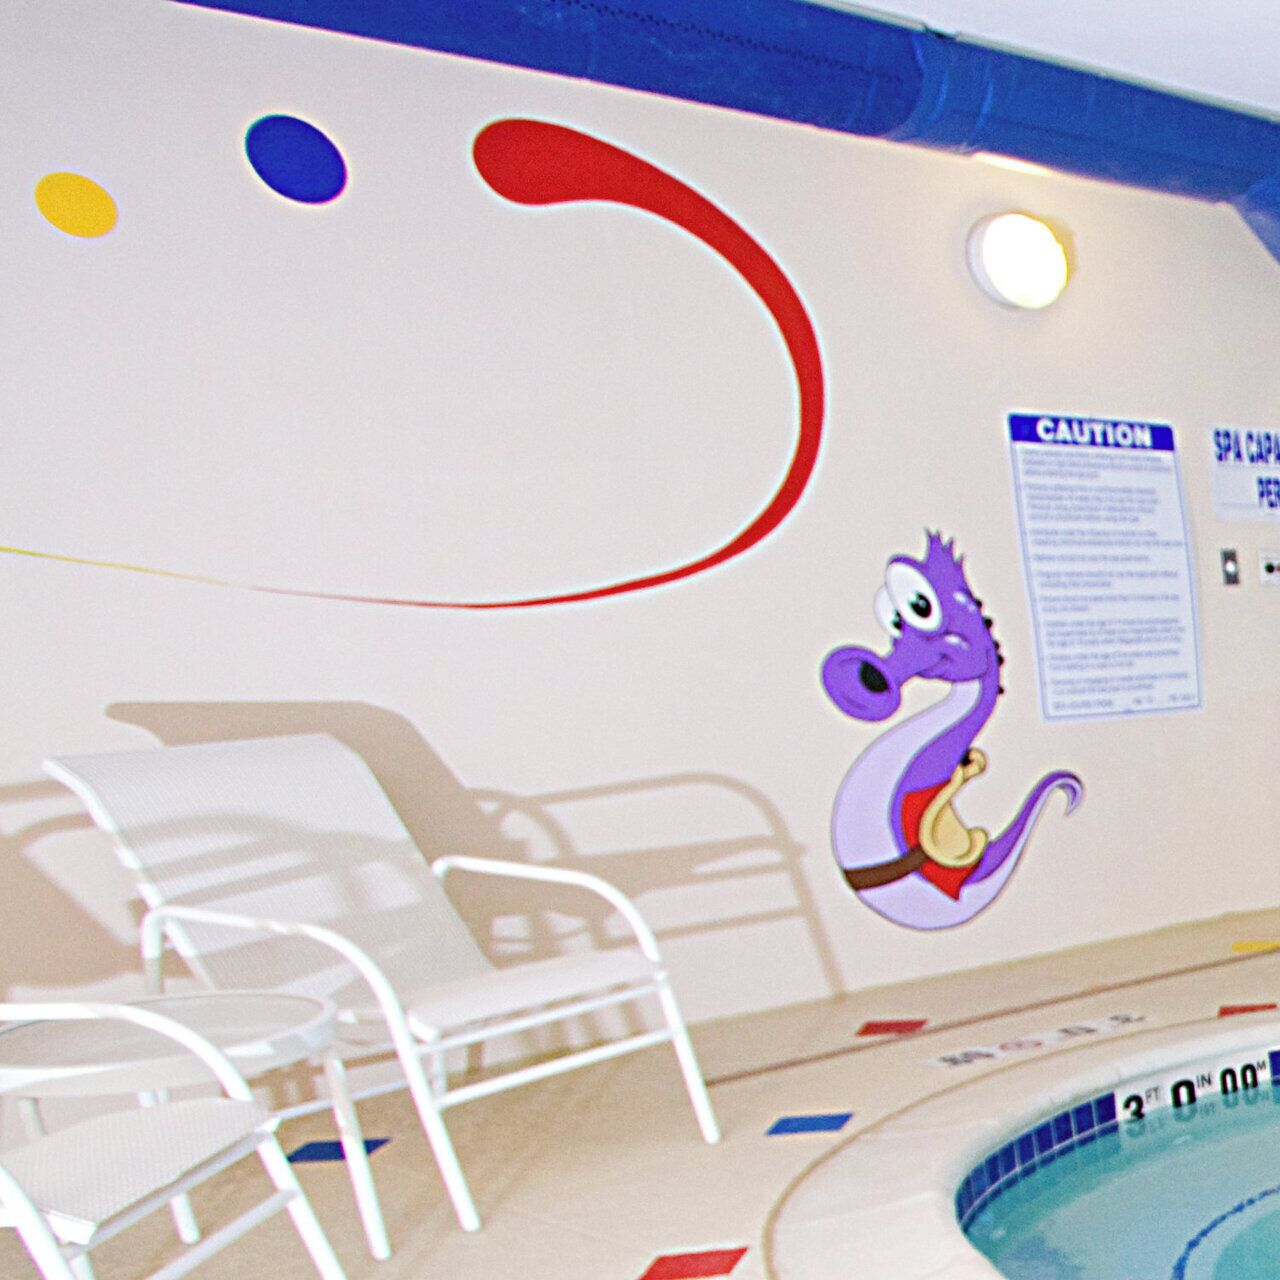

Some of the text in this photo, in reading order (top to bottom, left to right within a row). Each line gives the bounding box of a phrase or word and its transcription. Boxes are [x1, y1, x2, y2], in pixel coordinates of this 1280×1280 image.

[1036, 418, 1152, 447] CAUTION
[1214, 428, 1242, 461] SPA
[1196, 1072, 1212, 1089] IN
